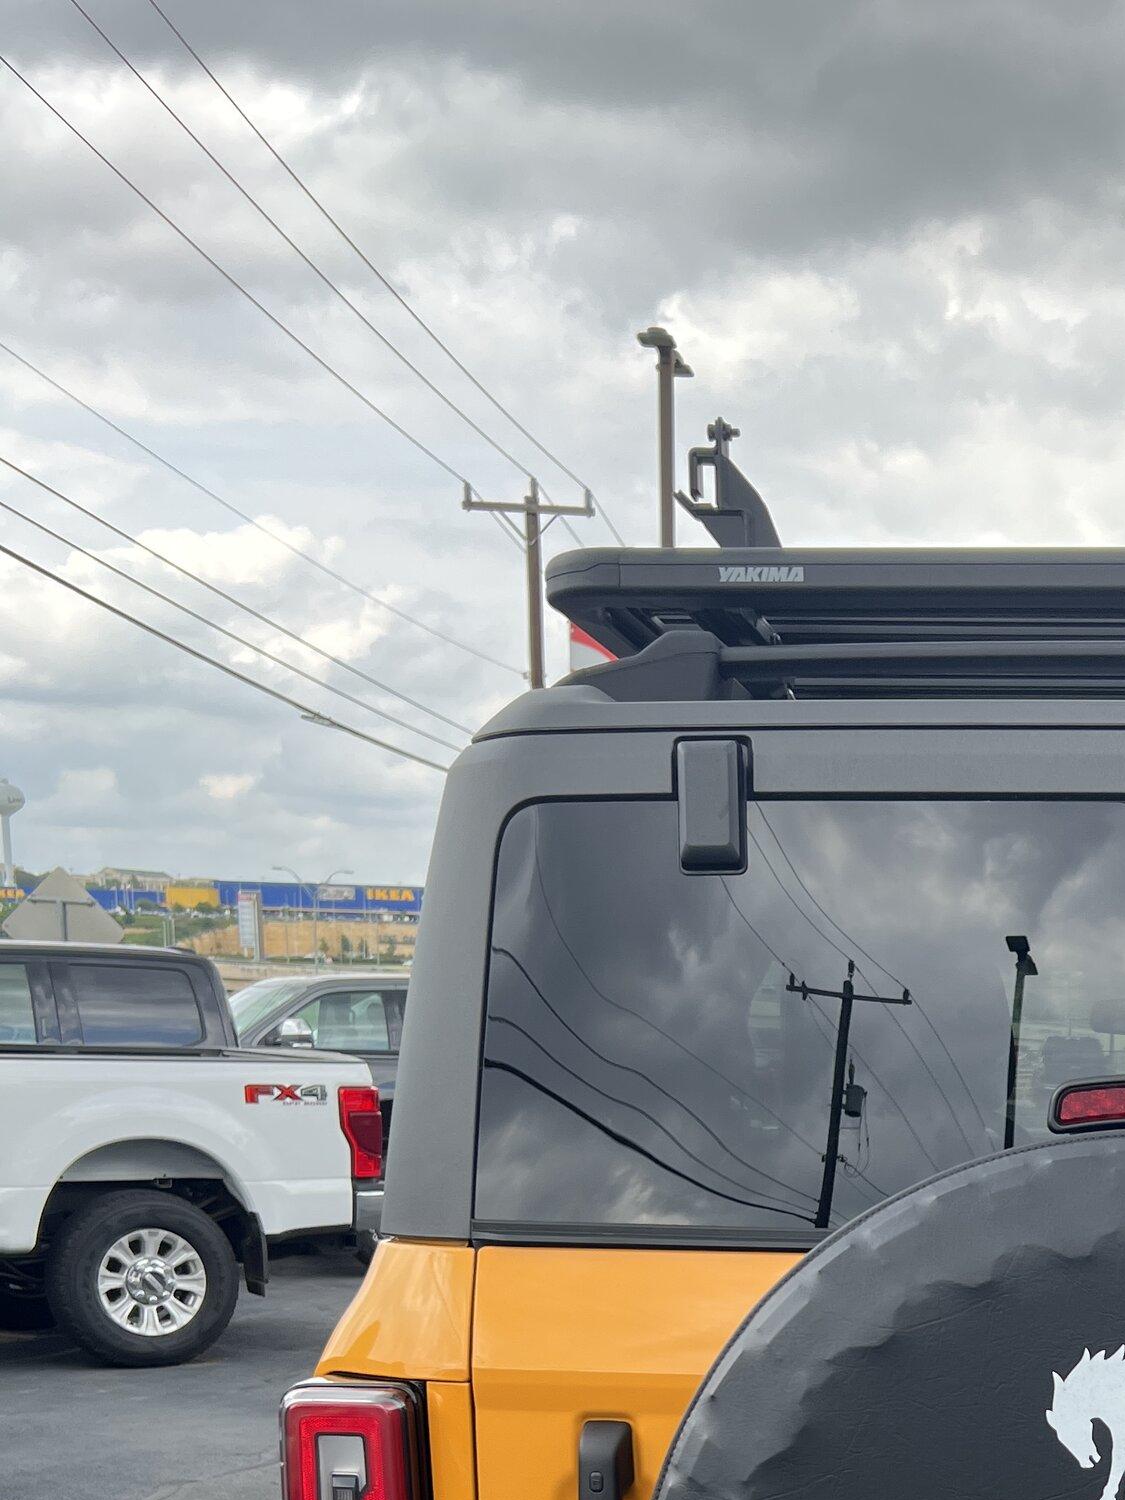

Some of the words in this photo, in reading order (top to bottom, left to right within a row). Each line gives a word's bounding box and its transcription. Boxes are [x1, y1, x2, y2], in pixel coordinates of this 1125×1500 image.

[718, 566, 804, 583] YAKIMA
[367, 888, 415, 901] IKEA
[244, 1084, 327, 1103] FX4
